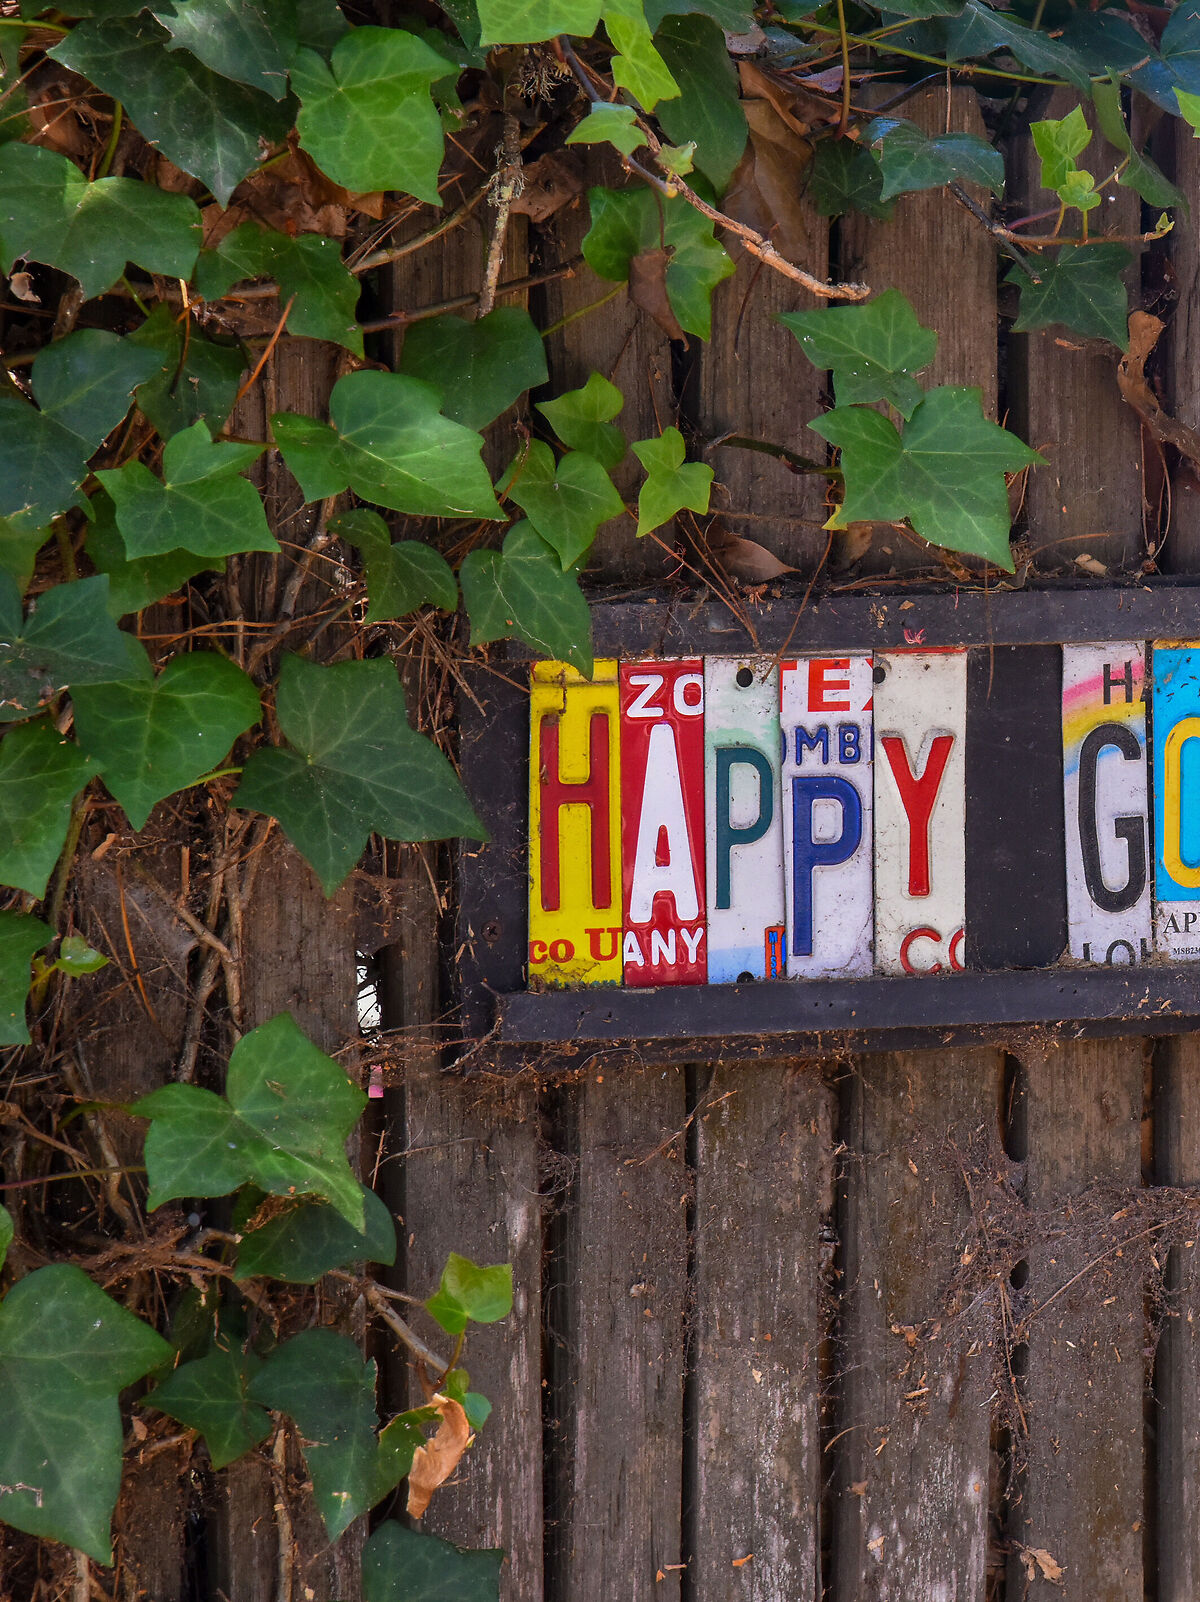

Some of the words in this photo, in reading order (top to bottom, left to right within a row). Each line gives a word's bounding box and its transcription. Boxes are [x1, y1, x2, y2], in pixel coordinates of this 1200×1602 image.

[1102, 660, 1146, 705] H
[539, 712, 955, 957] HAPPY
[623, 926, 704, 967] ANY
